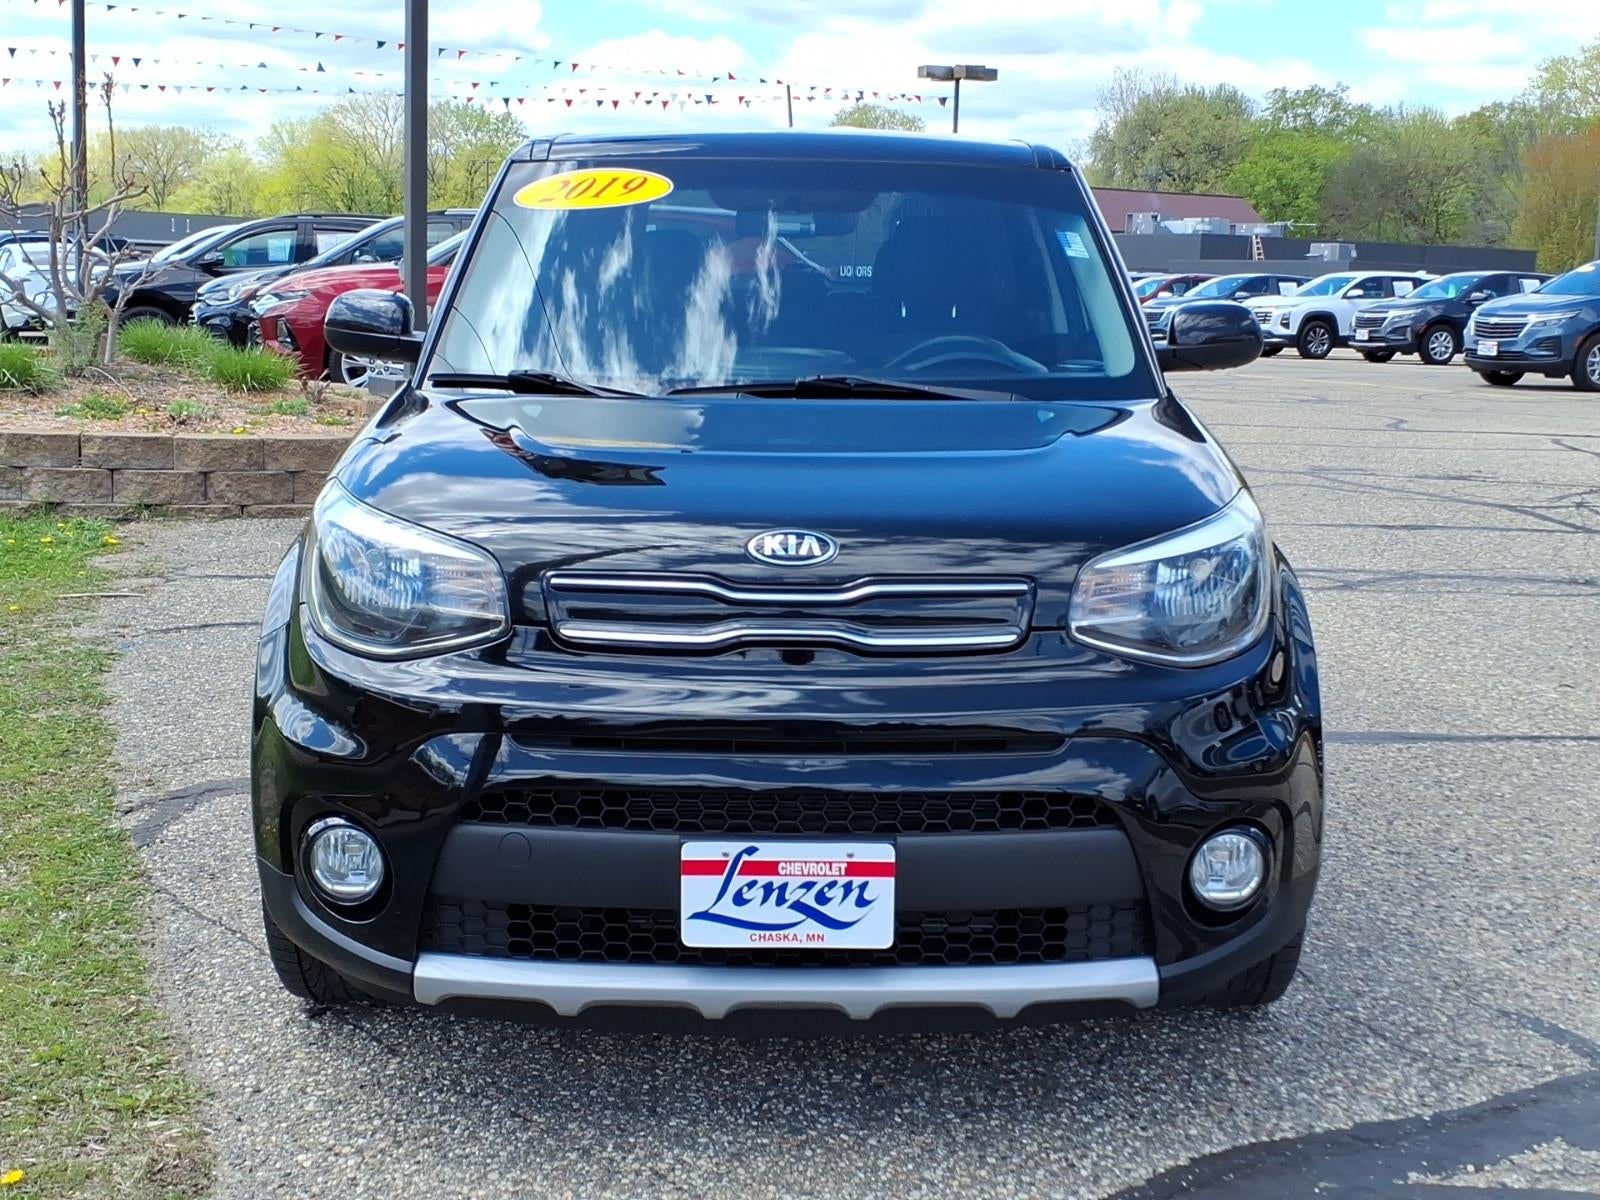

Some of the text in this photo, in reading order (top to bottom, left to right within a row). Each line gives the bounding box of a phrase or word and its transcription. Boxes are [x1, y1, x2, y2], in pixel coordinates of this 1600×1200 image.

[538, 176, 648, 203] 2019
[763, 534, 822, 556] KIA
[777, 862, 848, 876] CHEVROLET
[686, 845, 880, 931] Lenzen
[749, 933, 825, 943] CHASKA, MN
